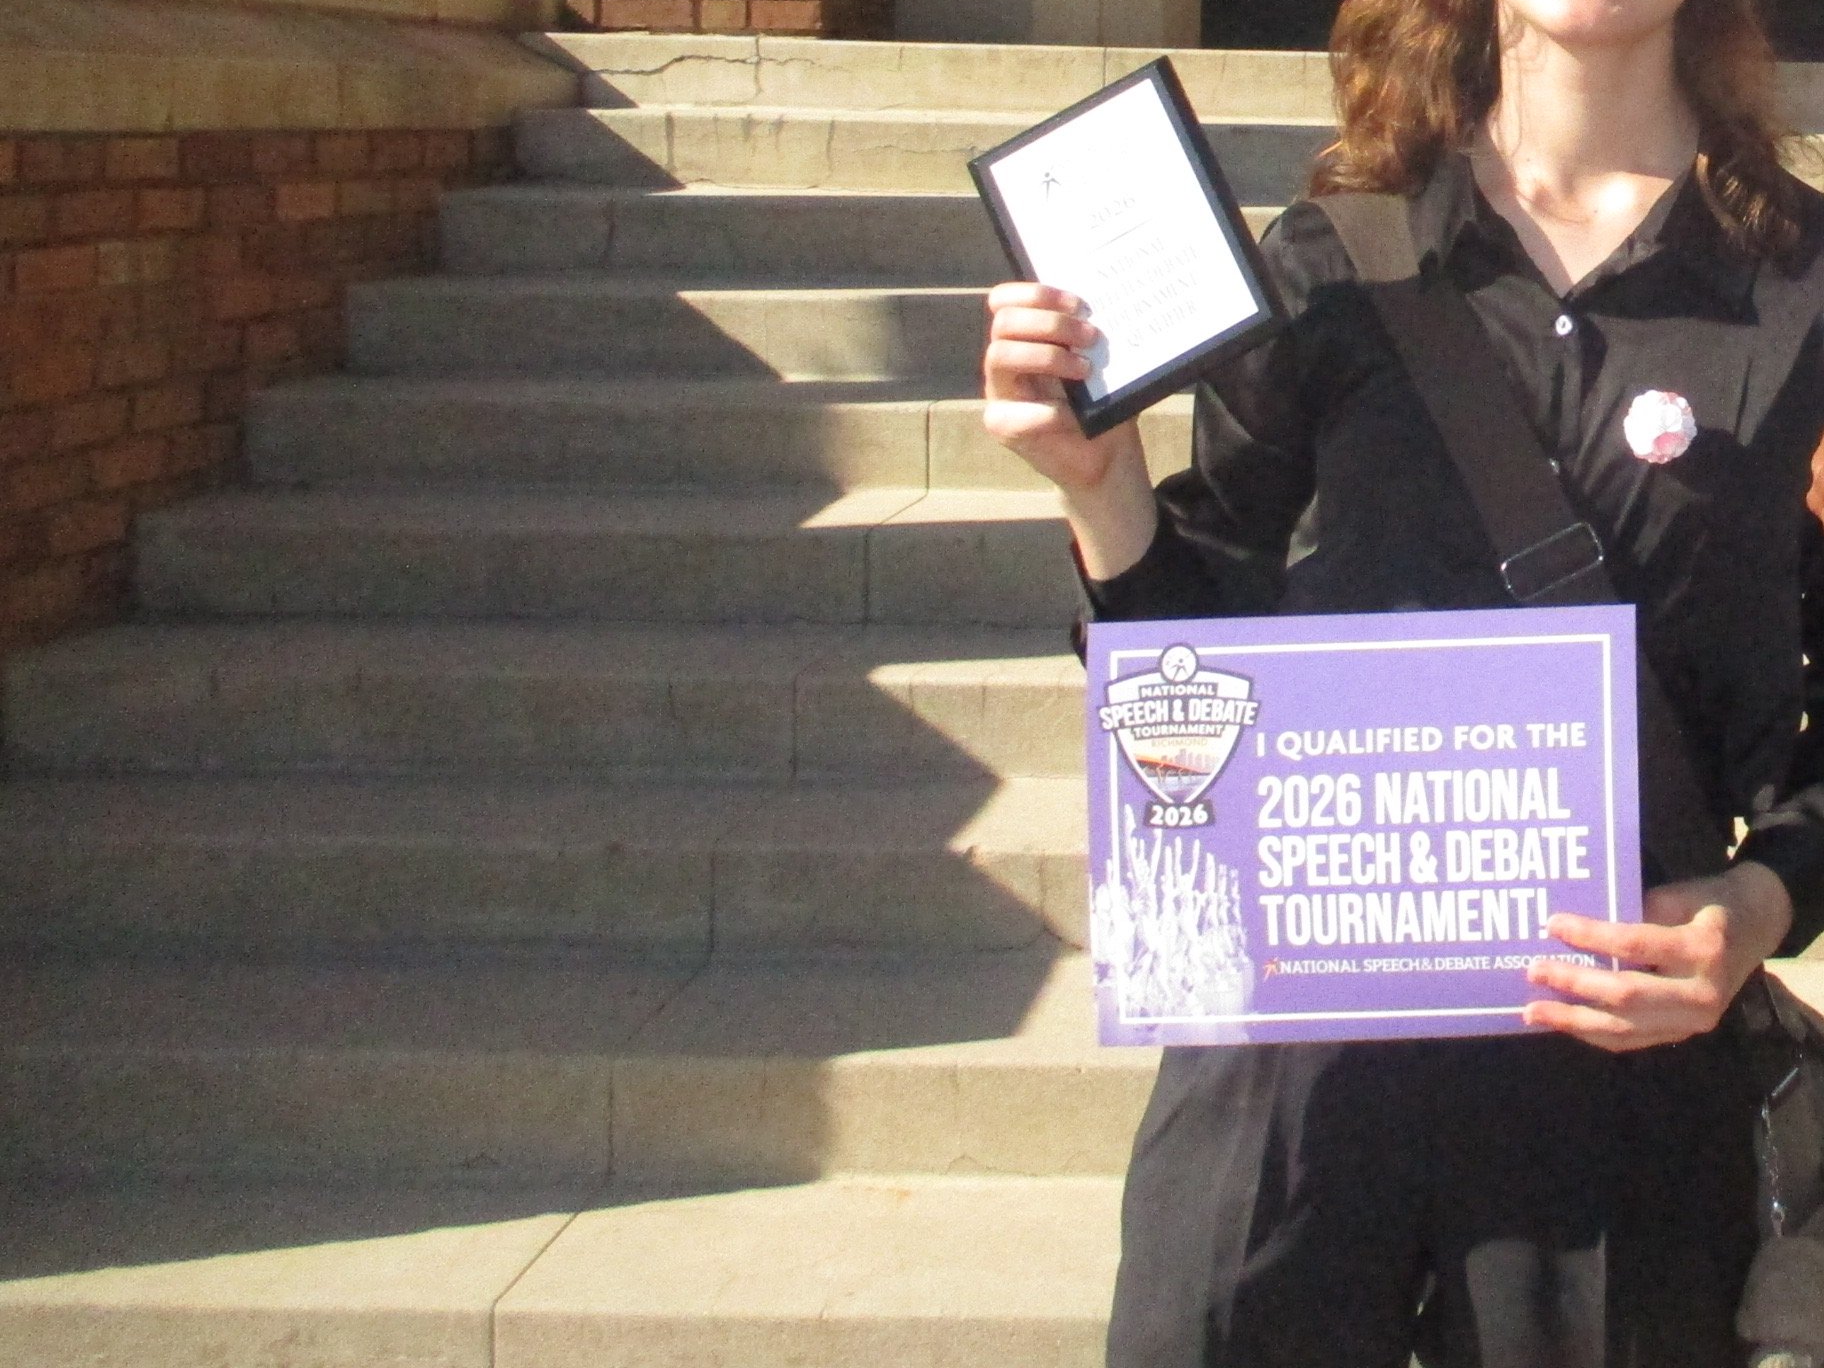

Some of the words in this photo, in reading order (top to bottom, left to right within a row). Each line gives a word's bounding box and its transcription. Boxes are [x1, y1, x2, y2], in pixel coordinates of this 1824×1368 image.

[1140, 685, 1215, 697] NATIONAL
[1099, 699, 1169, 730] SPEECH
[1172, 698, 1185, 722] &
[1188, 698, 1258, 725] DEBATE
[1133, 724, 1224, 738] TOURNAMENT
[1256, 732, 1265, 757] I
[1277, 726, 1443, 761] QUALIFIED
[1454, 724, 1517, 750] FOR
[1526, 722, 1587, 748] THE
[1257, 773, 1361, 828] 2026
[1375, 767, 1571, 825] NATIONAL
[1150, 803, 1208, 826] 2026
[1258, 832, 1401, 888] SPEECH
[1409, 830, 1438, 884] &
[1445, 826, 1591, 881] DEBATE
[1259, 887, 1549, 946] TOURNAMENT!
[1280, 959, 1360, 975] NATIONAL
